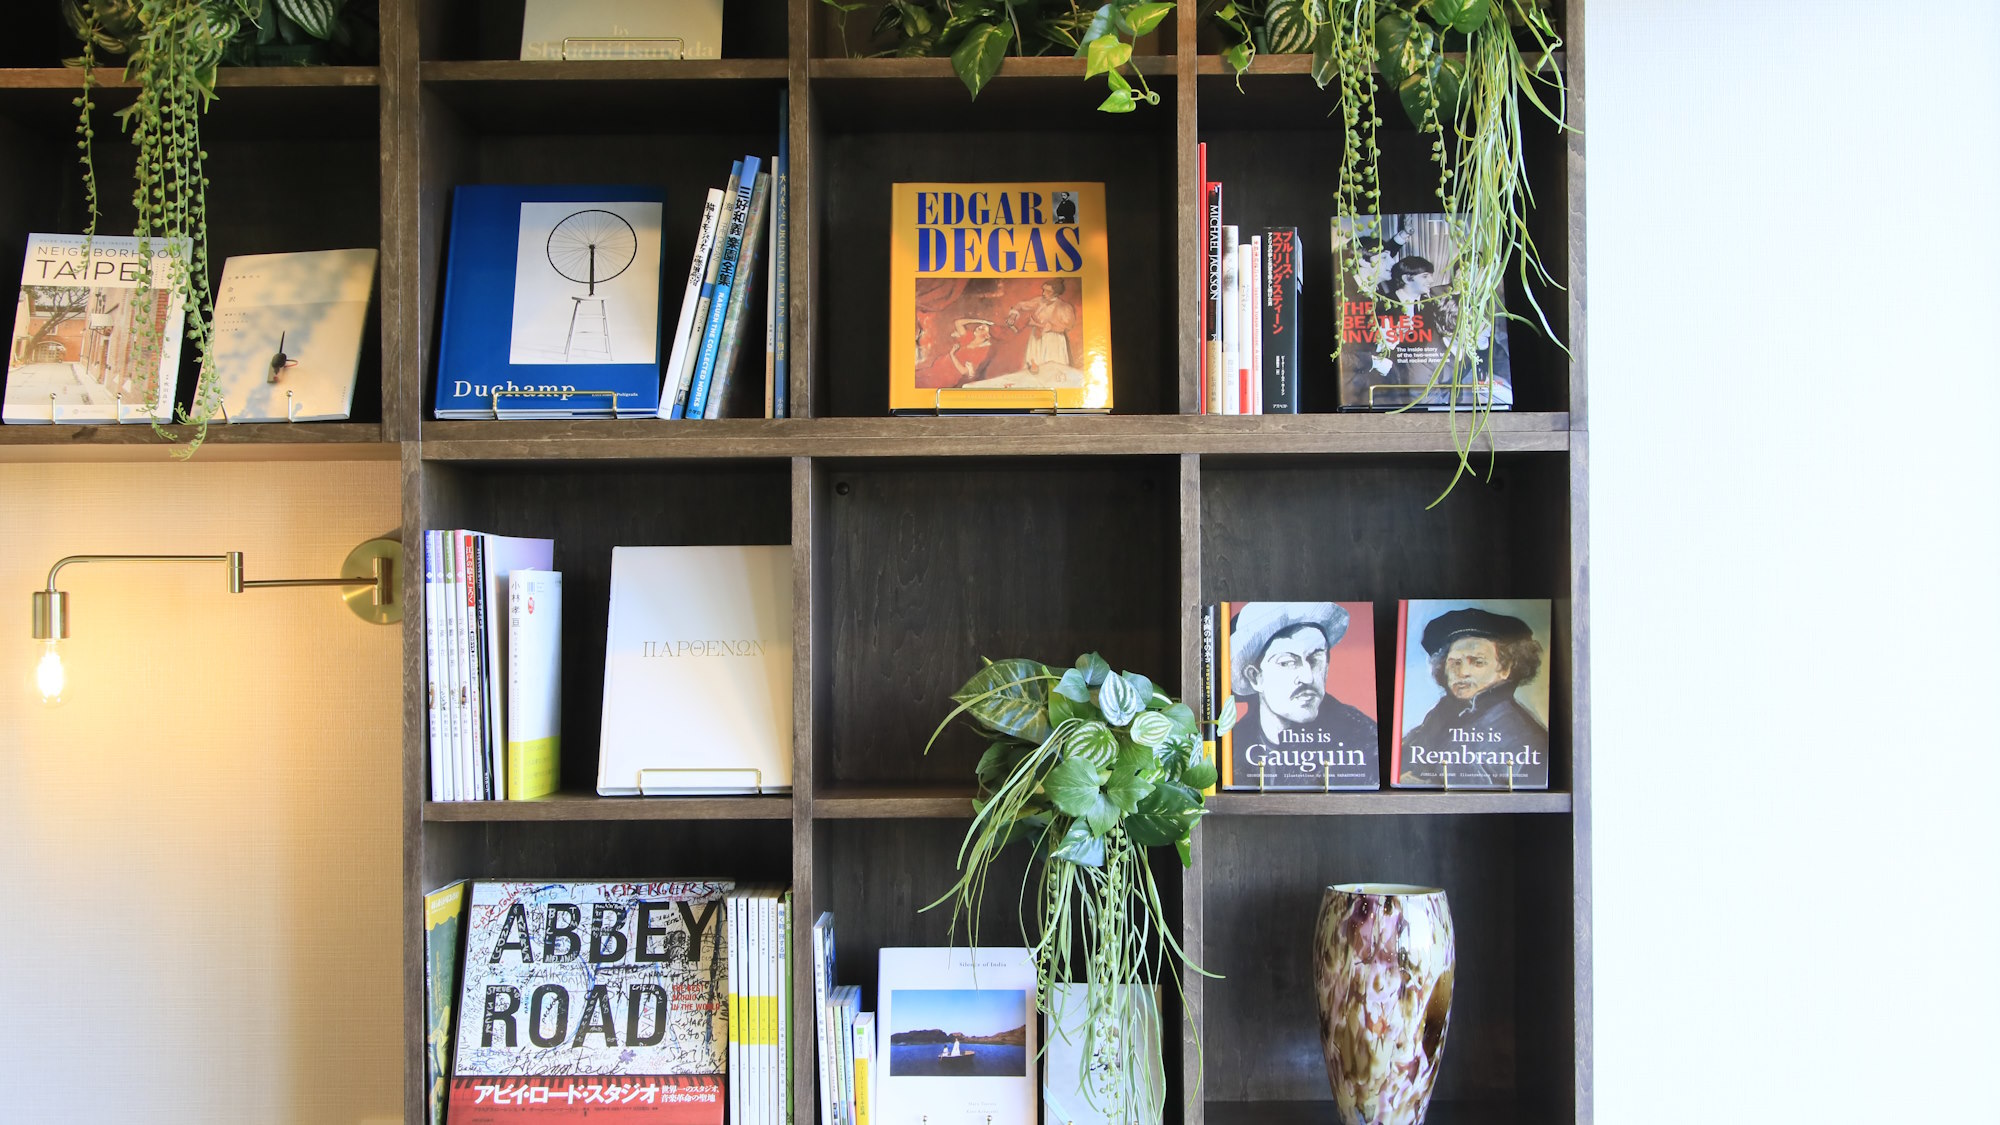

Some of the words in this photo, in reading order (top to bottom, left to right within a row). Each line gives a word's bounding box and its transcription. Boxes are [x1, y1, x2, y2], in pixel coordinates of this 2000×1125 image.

[915, 191, 1047, 225] EDGAR
[1209, 204, 1218, 251] MICHAEL
[718, 237, 741, 287] 楽園全集
[915, 227, 1083, 273] DEGAS
[1208, 254, 1218, 300] JACKSON
[1272, 231, 1284, 335] スプリングスティーン
[711, 292, 725, 323] RAKUEN
[1342, 302, 1374, 316] THE
[1342, 315, 1424, 330] BEATLES
[709, 323, 718, 339] THE
[700, 338, 714, 380] COLLECTED
[453, 380, 576, 401] Duchamp
[693, 381, 705, 408] WORKS
[642, 639, 767, 658] ΠΑΡΘΕΝΩΝ
[1281, 728, 1314, 743] This
[1317, 728, 1332, 743] is
[1448, 727, 1484, 743] This
[1488, 727, 1502, 743] is
[1245, 743, 1367, 773] Gauguin
[1409, 745, 1542, 766] Rembrandt
[488, 901, 721, 964] ABBEY
[480, 983, 667, 1048] ROAD
[473, 1083, 660, 1106] アビイ・ロード・スタジオ
